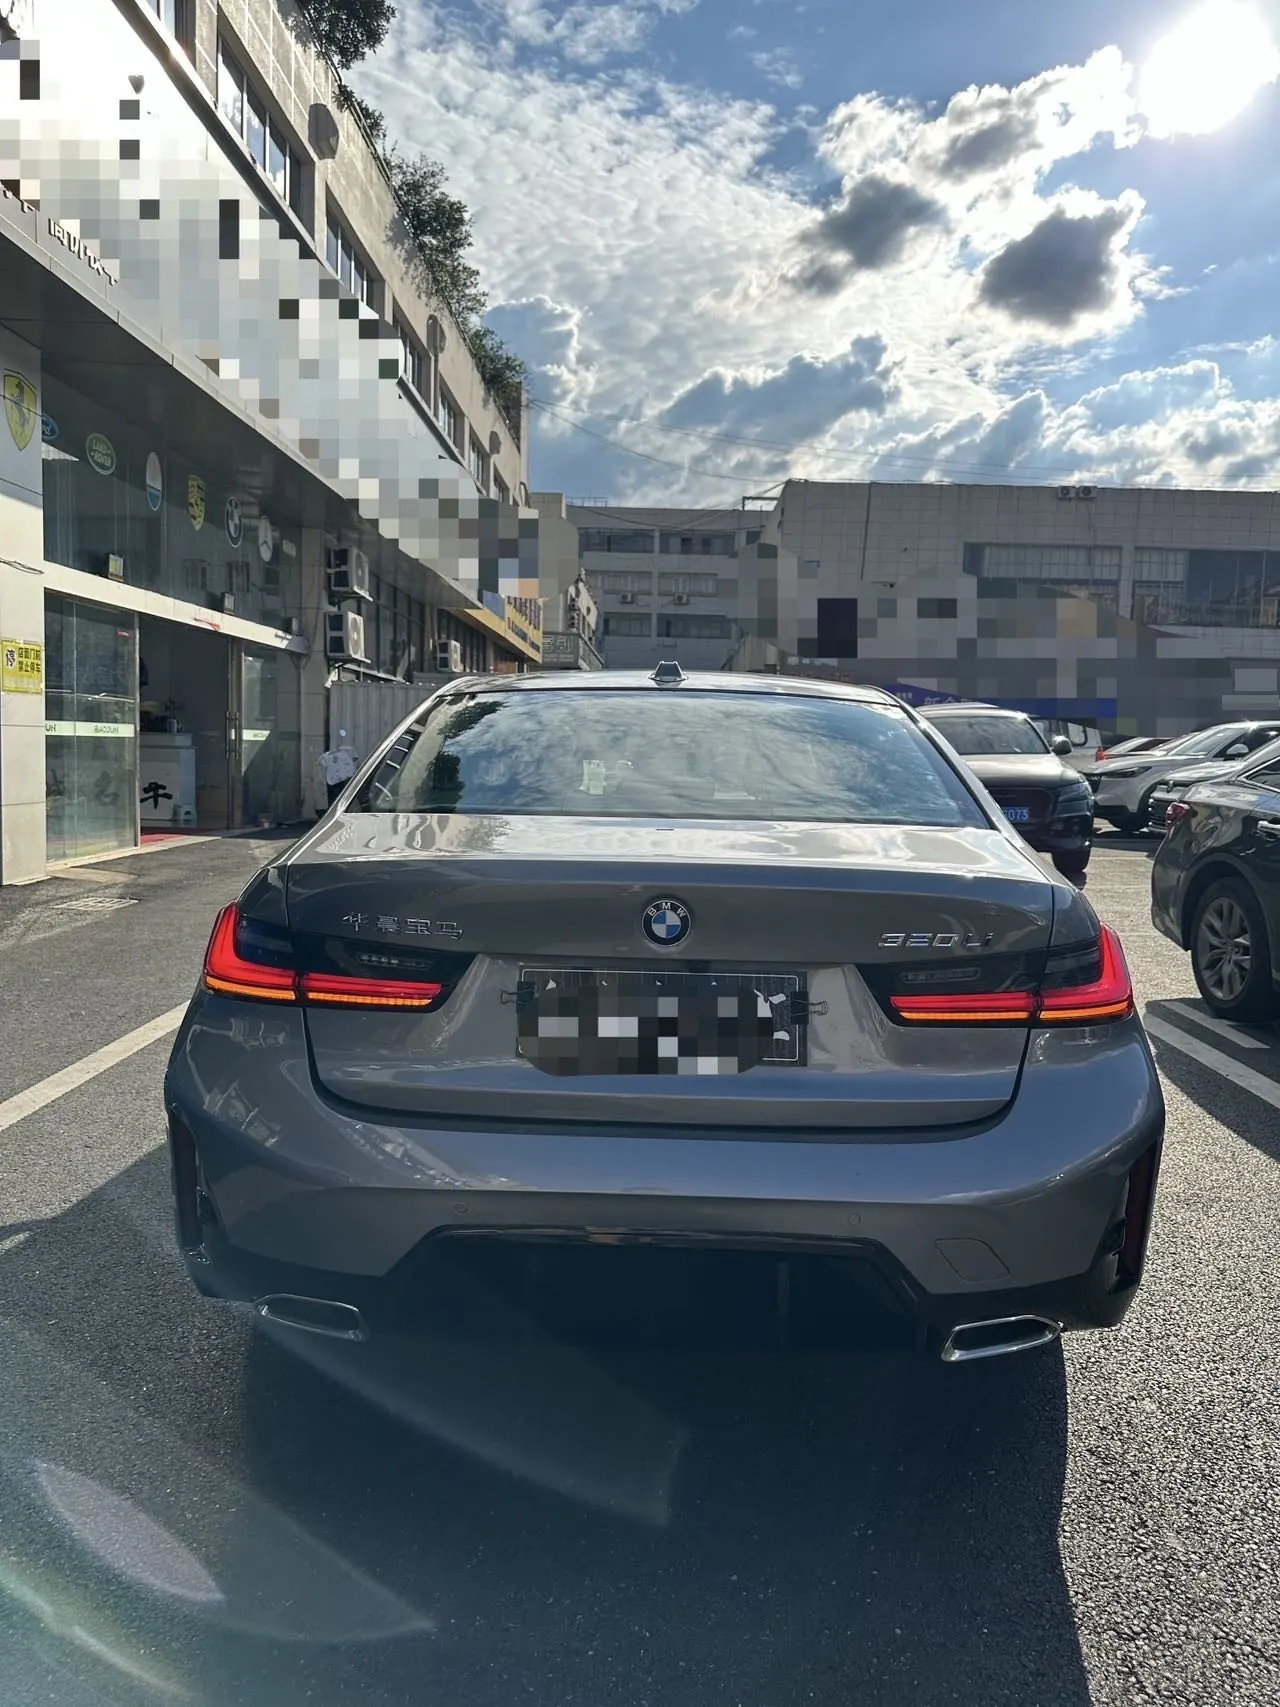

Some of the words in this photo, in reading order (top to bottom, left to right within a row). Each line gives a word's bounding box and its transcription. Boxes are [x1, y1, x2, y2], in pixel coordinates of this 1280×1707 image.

[647, 902, 686, 918] BMW
[341, 912, 463, 940] 华晨宝马
